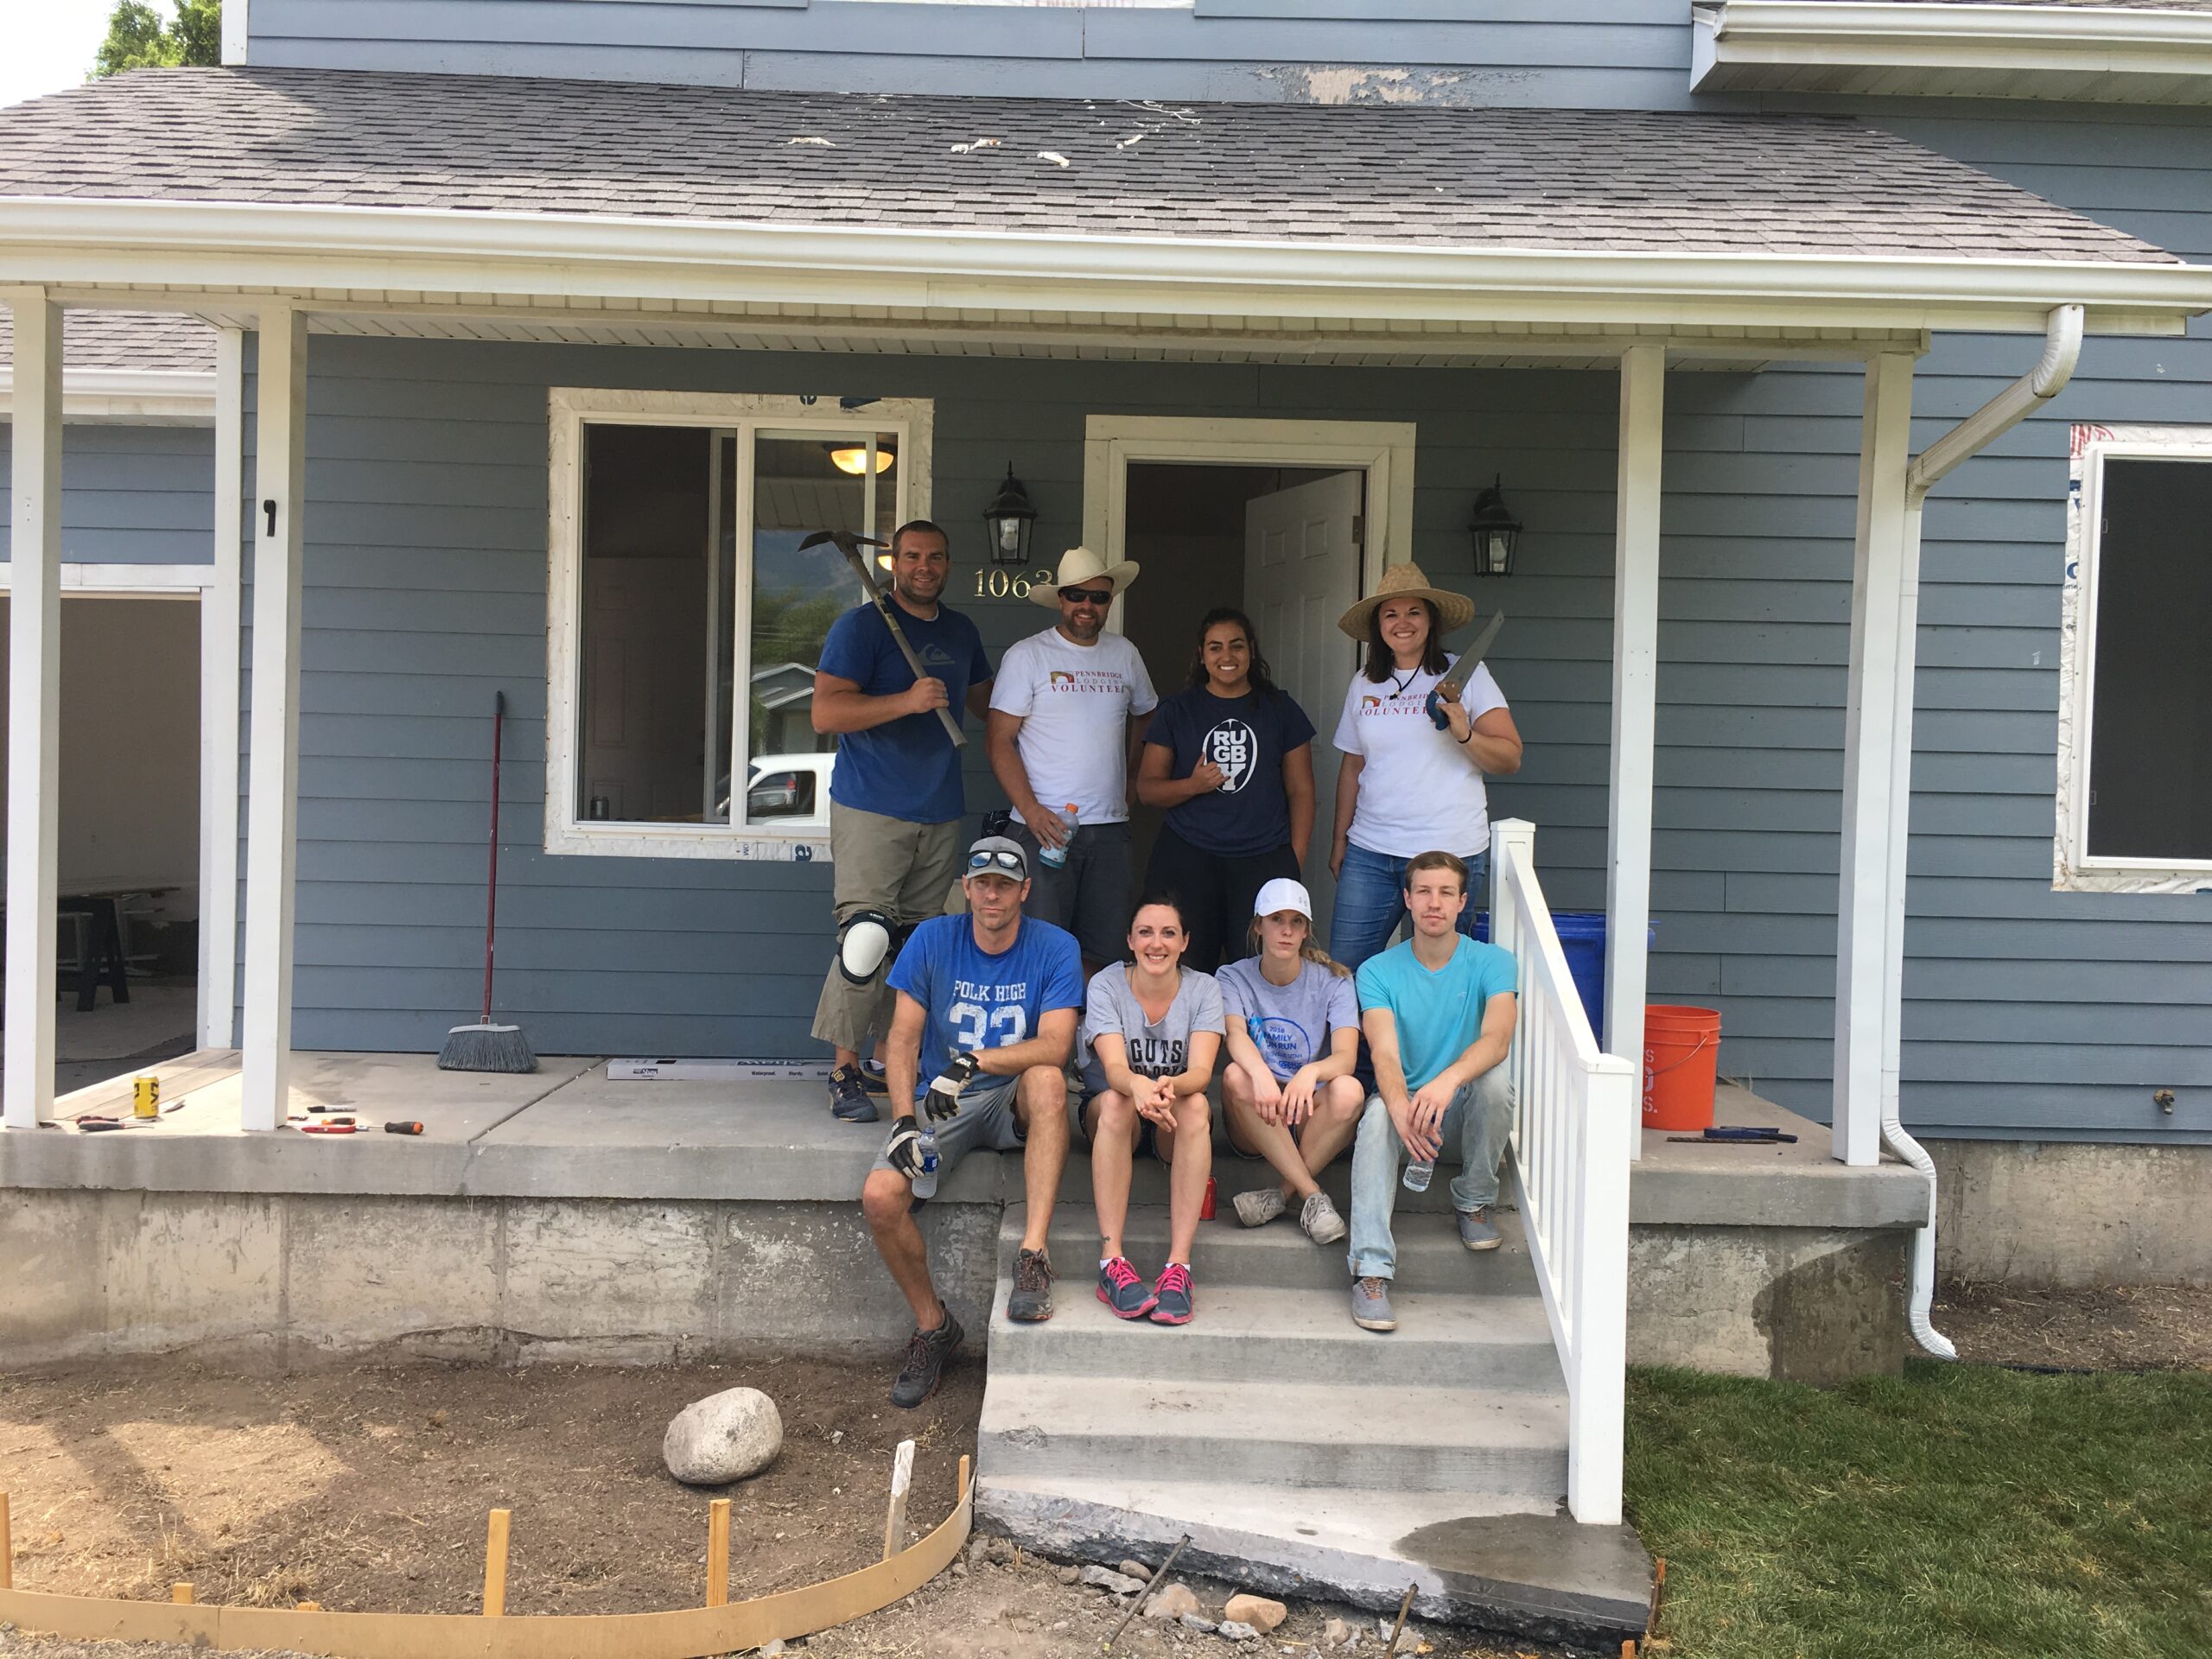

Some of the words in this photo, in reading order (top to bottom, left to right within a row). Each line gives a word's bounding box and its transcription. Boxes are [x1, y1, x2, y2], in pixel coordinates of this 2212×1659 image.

[953, 980, 990, 1001] POLK
[995, 982, 1027, 1001] HIGH
[1266, 1033, 1293, 1042] AMILY
[1130, 1038, 1183, 1064] GUTS
[1278, 1042, 1297, 1051] RUN
